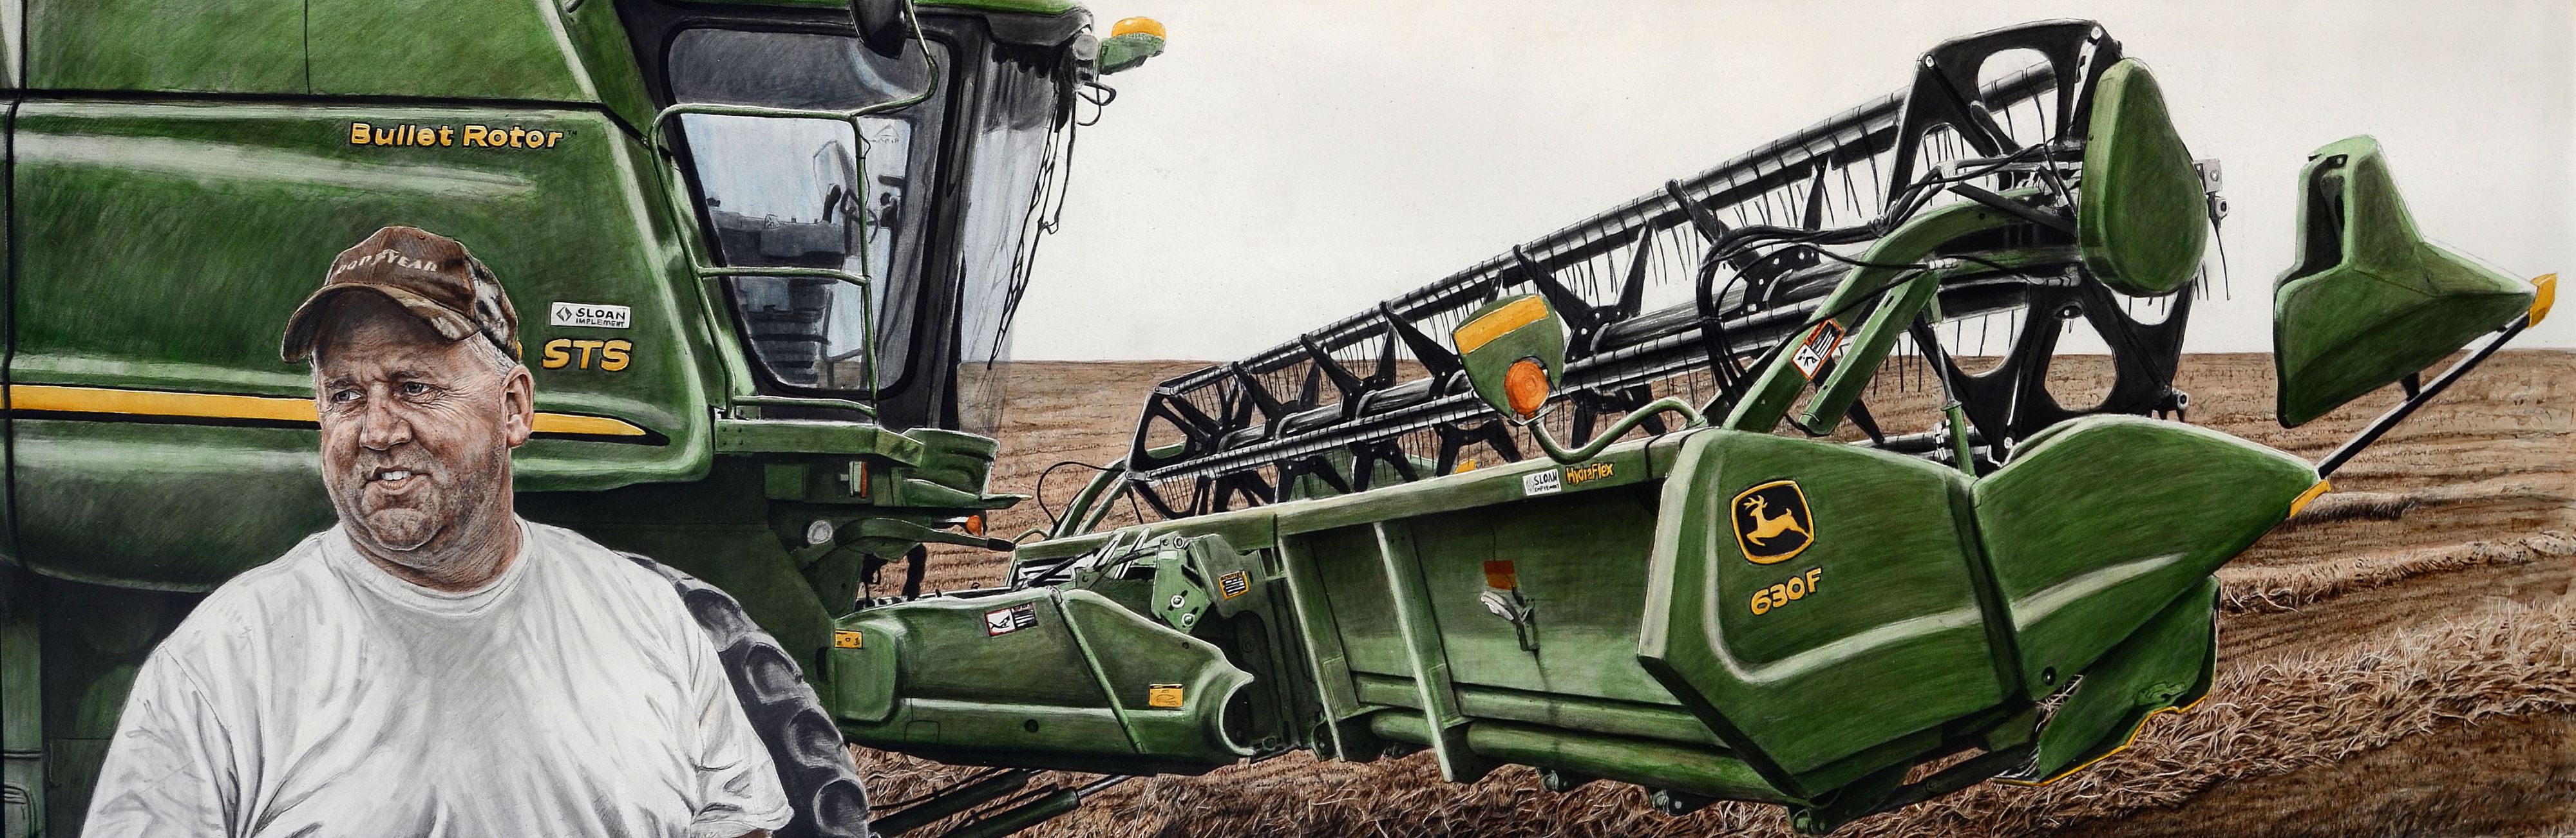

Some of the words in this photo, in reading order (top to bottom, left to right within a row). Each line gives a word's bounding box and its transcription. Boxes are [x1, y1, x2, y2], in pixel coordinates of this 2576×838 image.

[351, 122, 454, 147] Bullet
[462, 124, 564, 149] Rotor
[576, 308, 626, 320] SLOAN
[575, 319, 625, 328] IMPLEMENT
[542, 338, 632, 372] STS
[1533, 471, 1557, 485] SLOAN
[1566, 463, 1615, 485] HydraFlex
